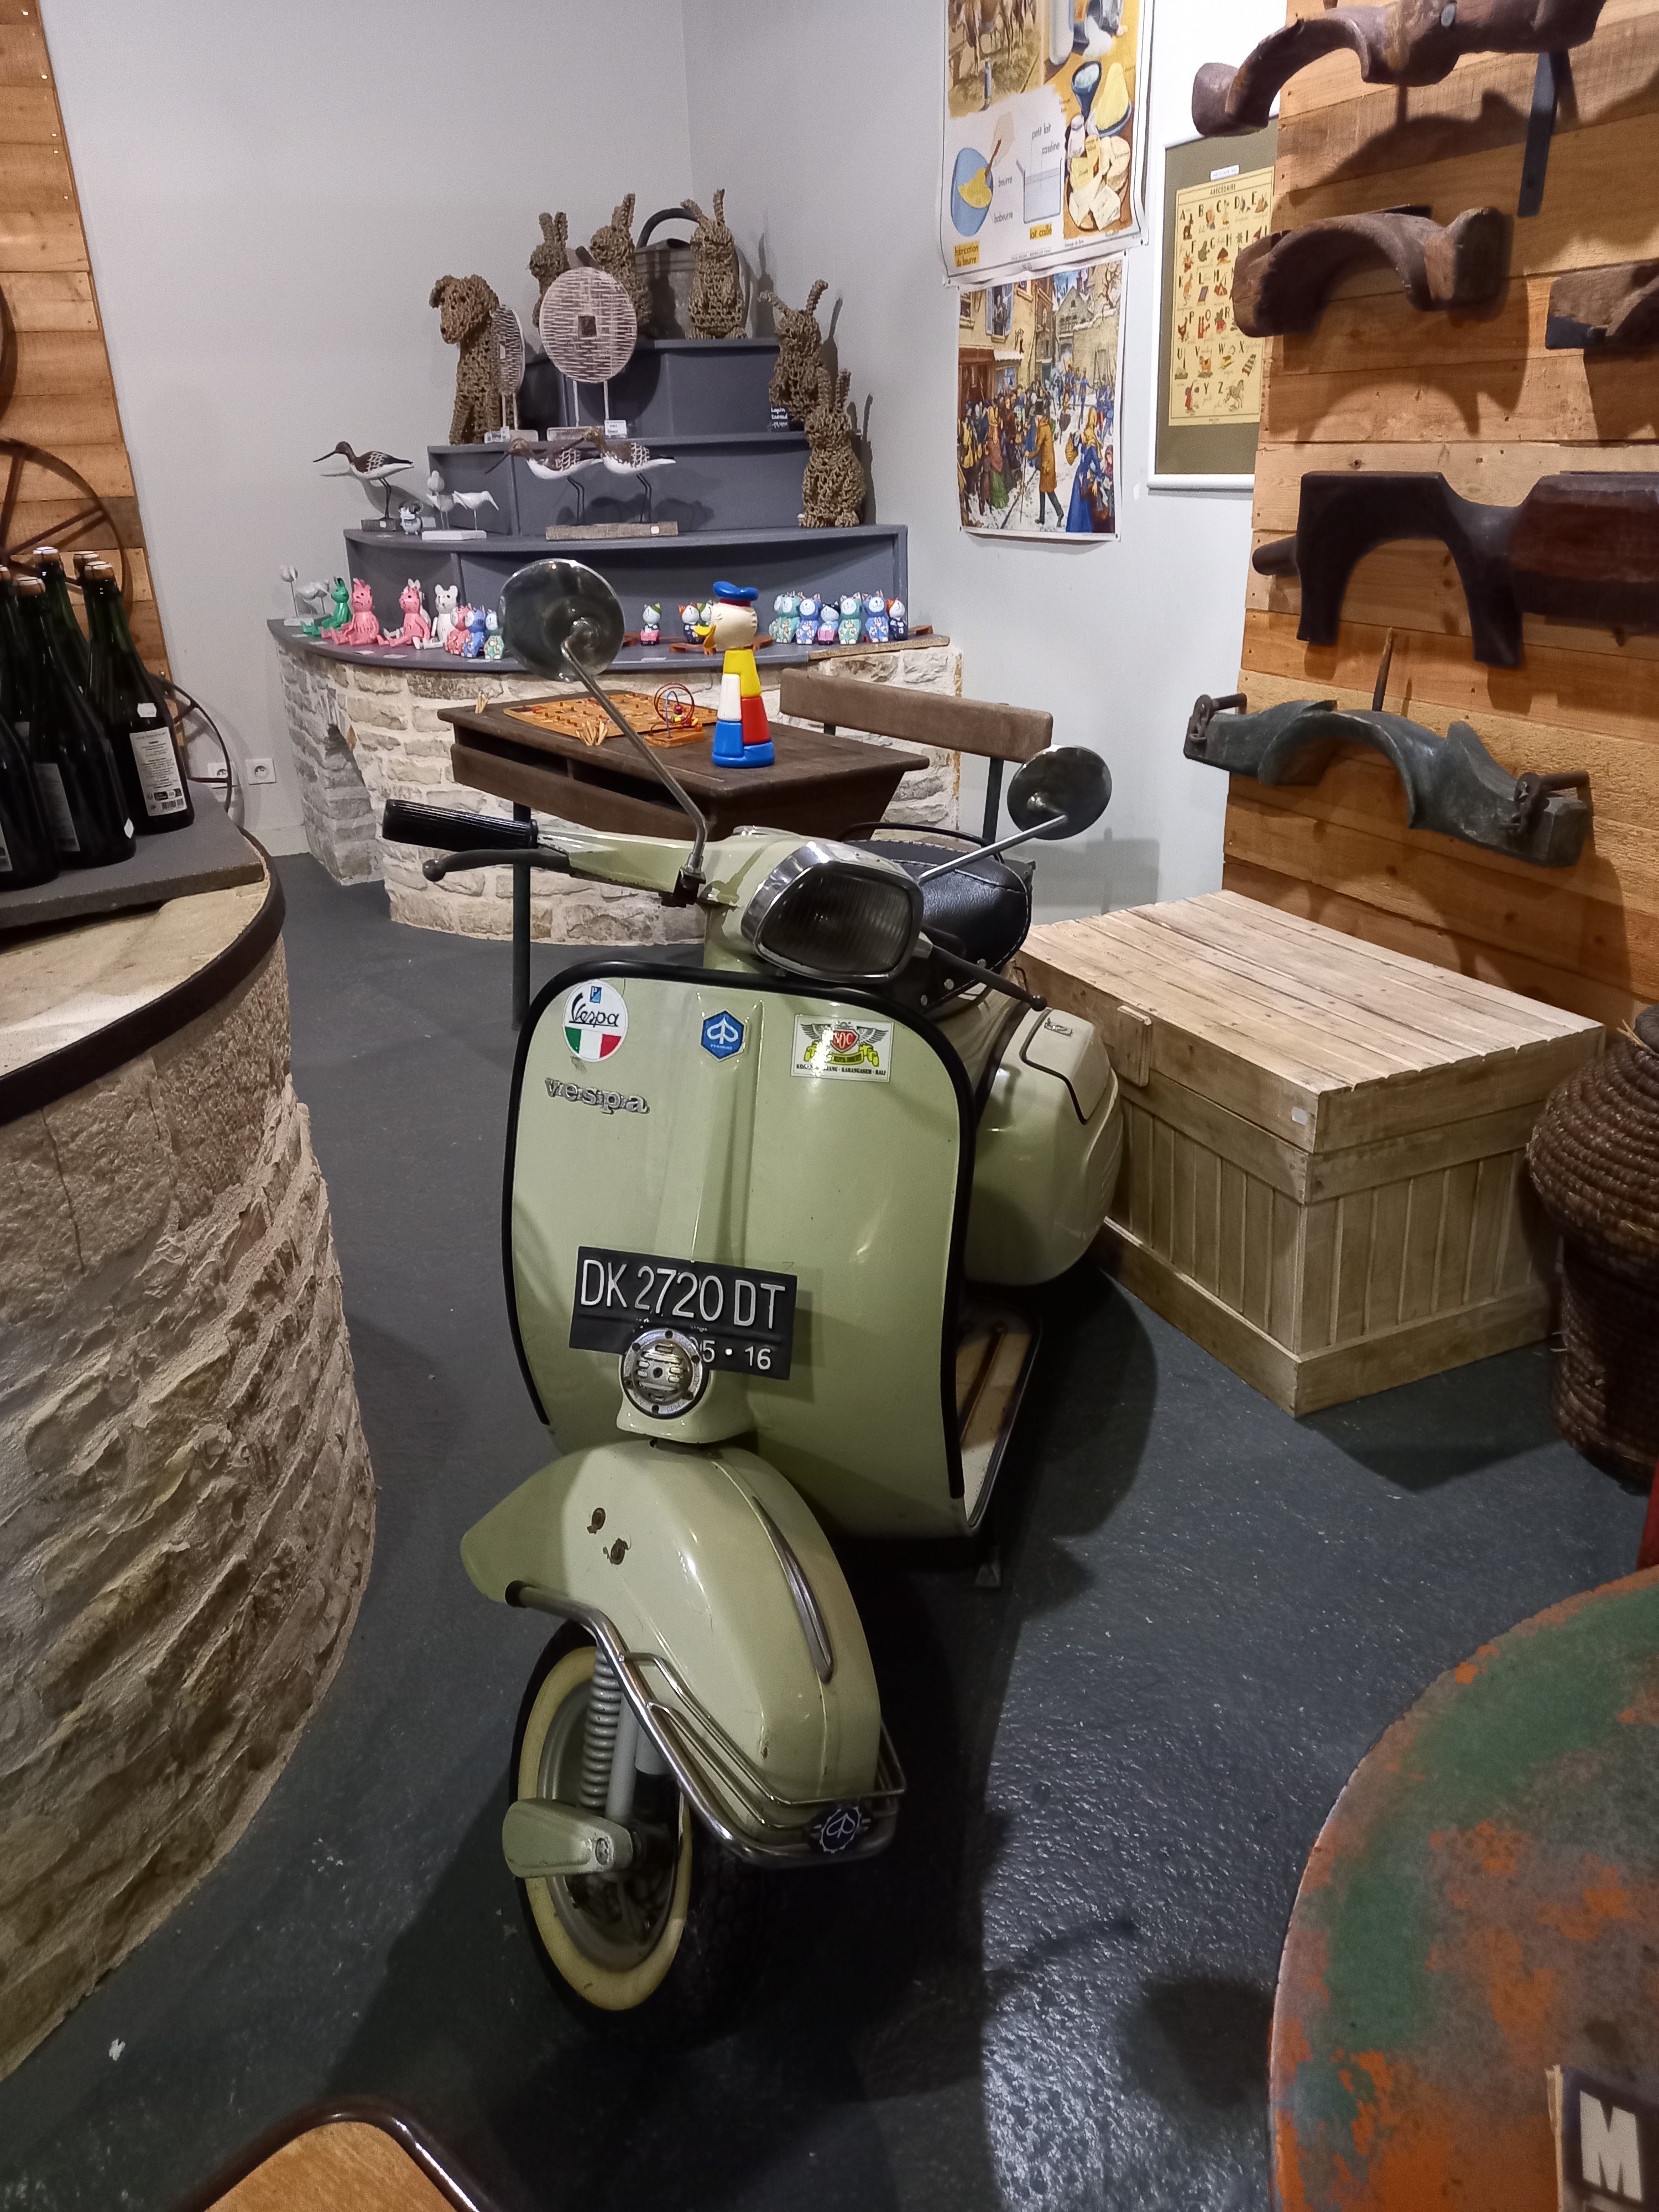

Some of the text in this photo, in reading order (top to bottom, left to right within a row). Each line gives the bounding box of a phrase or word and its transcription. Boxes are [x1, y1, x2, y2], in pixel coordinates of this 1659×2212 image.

[1032, 126, 1042, 140] petit
[998, 176, 1013, 187] beurre
[1179, 191, 1258, 221] A B C D E
[994, 212, 1013, 223] babeurre
[1191, 240, 1197, 254] F
[1226, 233, 1232, 247] H
[962, 255, 977, 266] beurre
[1178, 275, 1183, 288] K
[1198, 272, 1204, 285] L
[1213, 269, 1220, 283] M
[1189, 310, 1194, 324] P
[1224, 306, 1230, 319] R
[1177, 347, 1183, 360] U
[1195, 345, 1201, 357] V
[1218, 342, 1225, 354] W
[1239, 340, 1245, 353] X
[1204, 381, 1224, 395] Y Z
[571, 992, 619, 1028] Vespa
[544, 1077, 650, 1115] vespa
[581, 1259, 786, 1329] DK 2720 DT
[744, 1345, 771, 1370] 16
[1579, 2090, 1642, 2201] M
